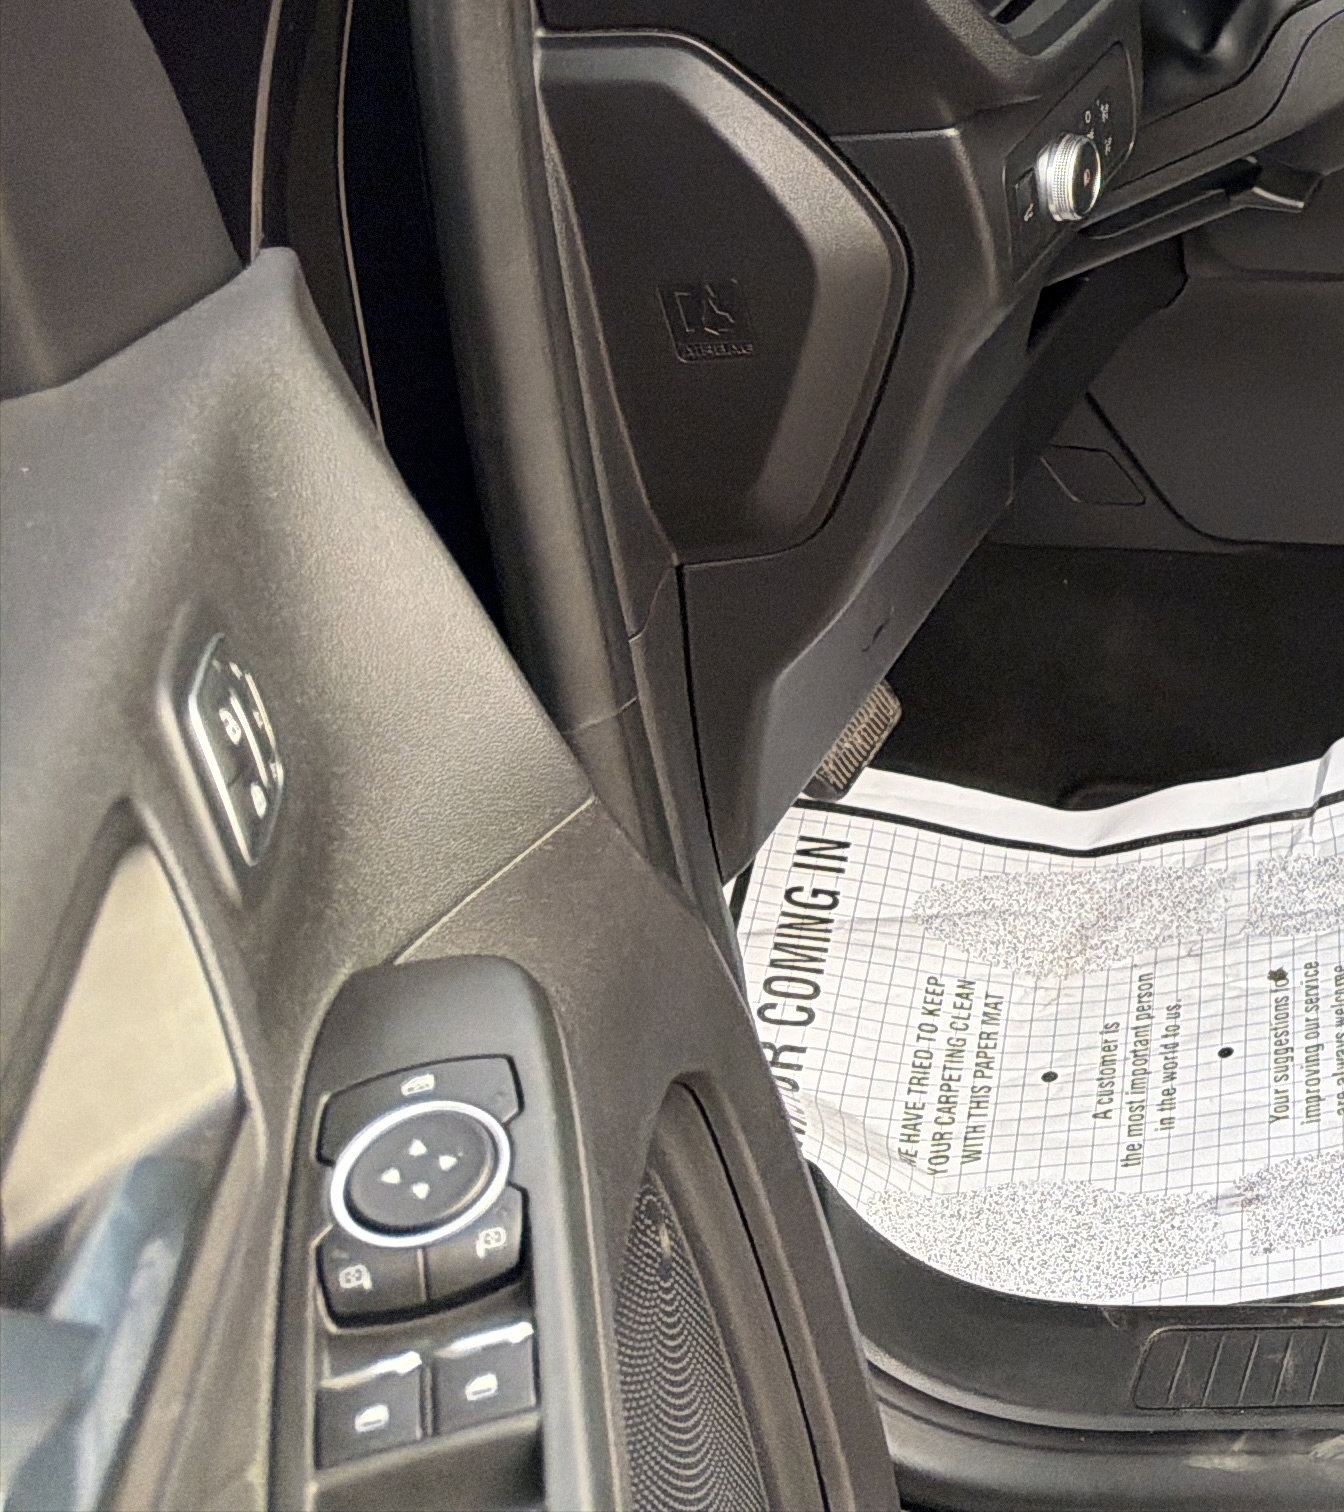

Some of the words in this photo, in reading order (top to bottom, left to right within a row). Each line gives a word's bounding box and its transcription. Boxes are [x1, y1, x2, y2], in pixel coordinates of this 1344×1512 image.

[792, 836, 851, 874] IN
[757, 886, 840, 1028] COMING
[921, 976, 946, 1015] KEEP
[1135, 972, 1155, 1021] person
[1267, 968, 1289, 994] fo
[1300, 960, 1319, 1015] service
[951, 978, 977, 1031] CLEAN
[985, 993, 1004, 1026] MAT
[1166, 999, 1182, 1020] us.
[917, 1015, 939, 1045] TO
[1100, 1021, 1120, 1036] is
[1162, 1023, 1180, 1041] to
[1270, 995, 1294, 1083] suggestions
[1304, 1015, 1320, 1041] our
[908, 1044, 931, 1098] TRIED
[974, 1023, 999, 1080] PAPER
[1096, 1037, 1118, 1106] customer
[1125, 1025, 1152, 1095] important
[1159, 1040, 1179, 1085] world
[932, 1036, 966, 1128] CARPETING
[967, 1080, 993, 1123] THIS
[1156, 1087, 1176, 1113] the
[1301, 1042, 1324, 1126] improving
[900, 1100, 925, 1144] HAVE
[1092, 1109, 1113, 1120] A
[1126, 1100, 1145, 1138] most
[1155, 1116, 1175, 1131] in
[1269, 1086, 1289, 1125] Your
[927, 1123, 953, 1176] YOUR
[960, 1119, 984, 1165] WITH
[1121, 1142, 1143, 1168] the
